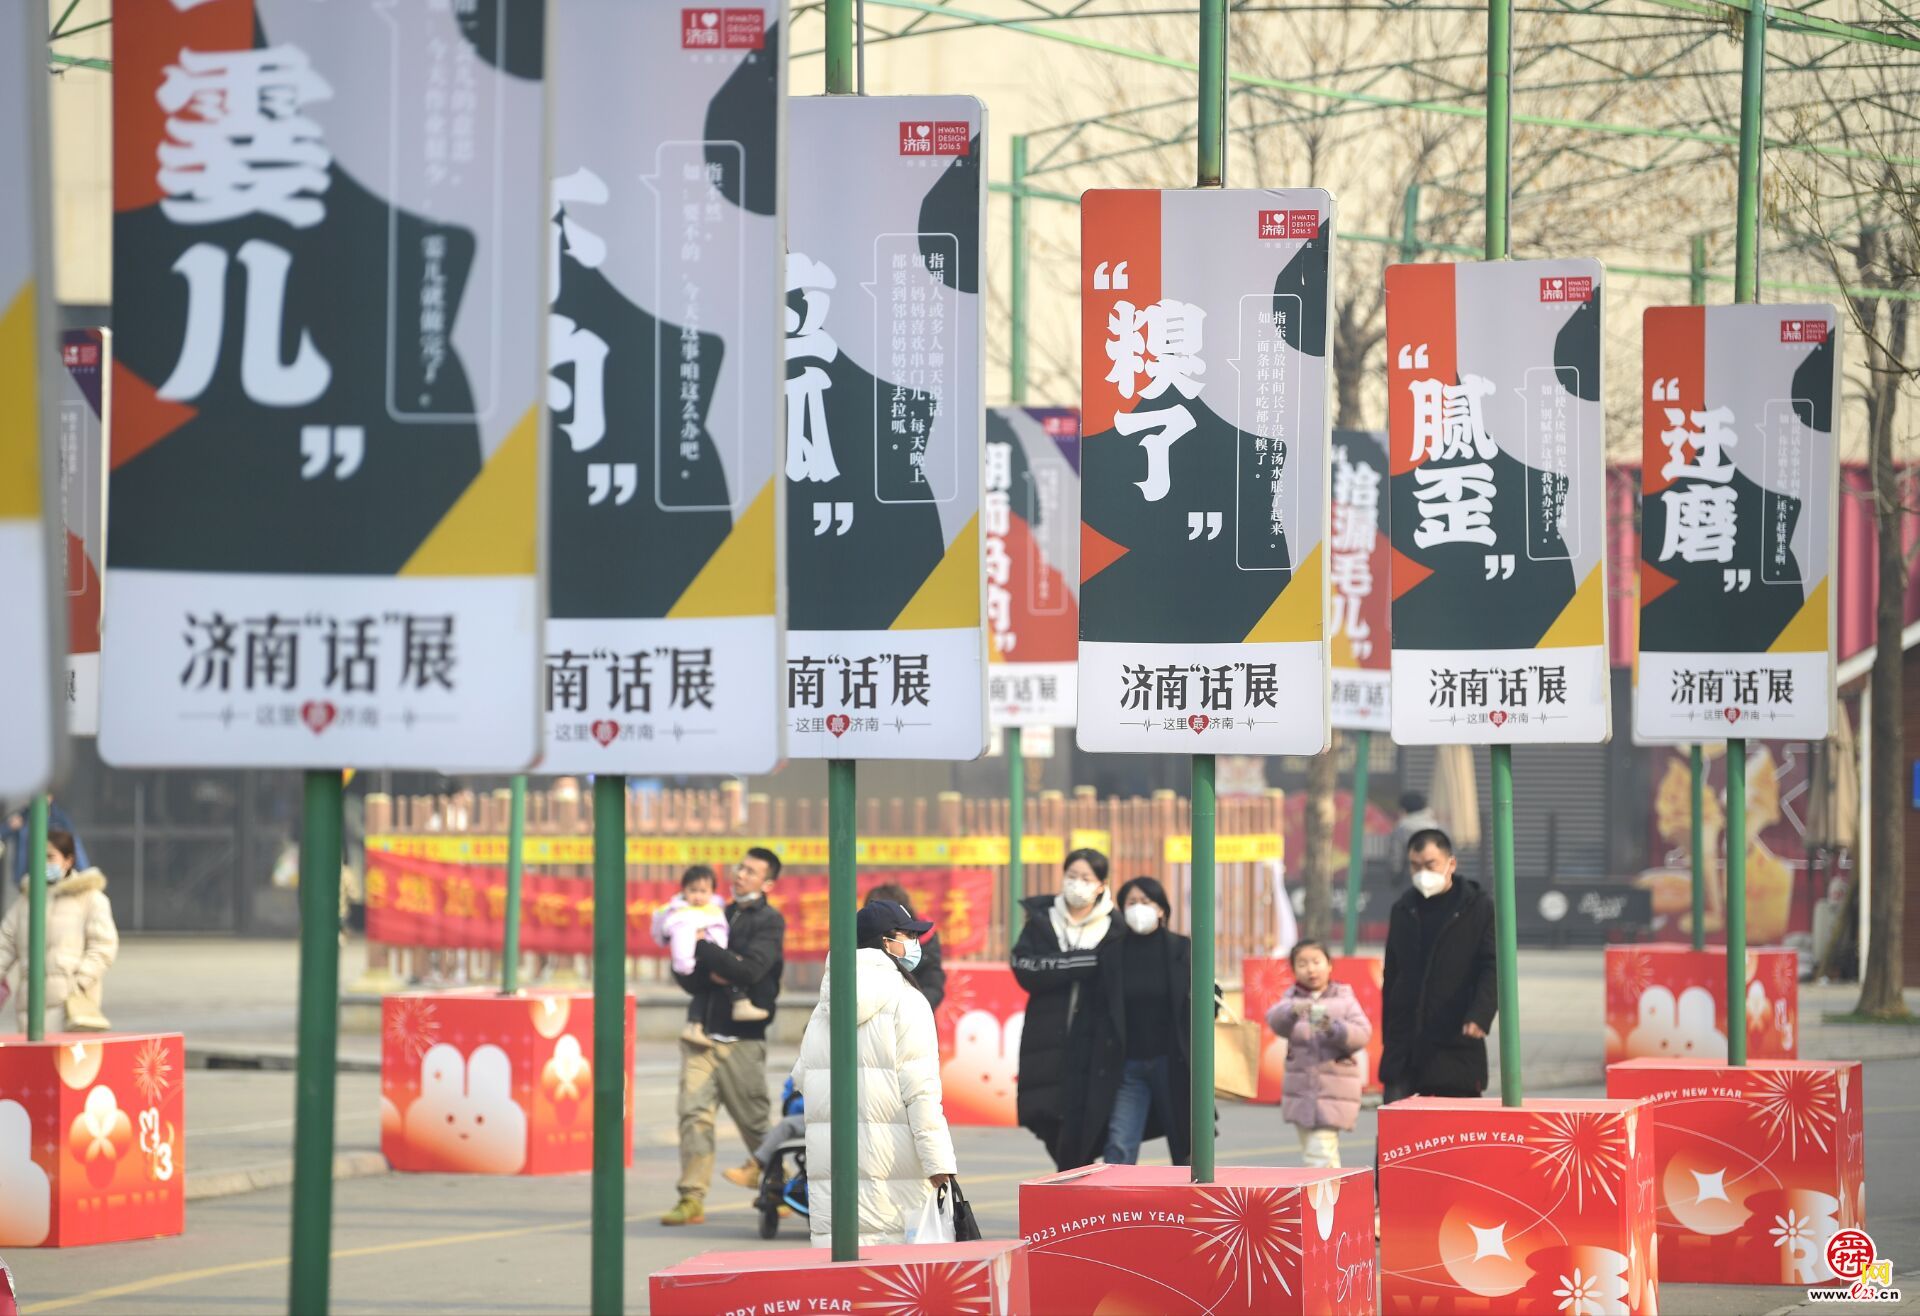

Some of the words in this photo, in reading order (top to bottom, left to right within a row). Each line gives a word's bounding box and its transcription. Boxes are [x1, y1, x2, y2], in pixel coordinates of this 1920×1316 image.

[686, 28, 719, 45] 济南
[903, 138, 931, 152] 济南
[938, 126, 966, 134] HWATO
[938, 134, 966, 142] DESIGN
[1262, 225, 1285, 236] 济南
[928, 252, 945, 432] 指两人或多人聊天说话。
[1255, 311, 1271, 479] 如：面条再不吃都放糗了。
[1270, 311, 1287, 549] 指东西放时间长了没有汤水胀了起来。
[180, 611, 458, 693] 济南“话”展
[544, 646, 715, 713] 南“话”展
[787, 653, 931, 710] 南“话”展
[1120, 663, 1279, 711] 济南“话”展
[1429, 665, 1567, 709] 济南“话”展
[1671, 668, 1794, 705] 济南“话”展
[795, 716, 880, 733] 这里最济南
[1682, 1087, 1708, 1097] NEW
[1712, 1087, 1742, 1098] YEAR
[1383, 1145, 1411, 1162] 2023
[1415, 1135, 1455, 1151] HAPPY
[1460, 1132, 1487, 1142] NEW
[1492, 1131, 1525, 1144] YEAR
[1024, 1227, 1057, 1246] 2023
[1061, 1214, 1106, 1233] HAPPY
[1112, 1211, 1143, 1223] NEW
[1149, 1211, 1185, 1225] YEAR
[764, 1299, 801, 1315] NEW
[808, 1298, 852, 1312] YEAR
